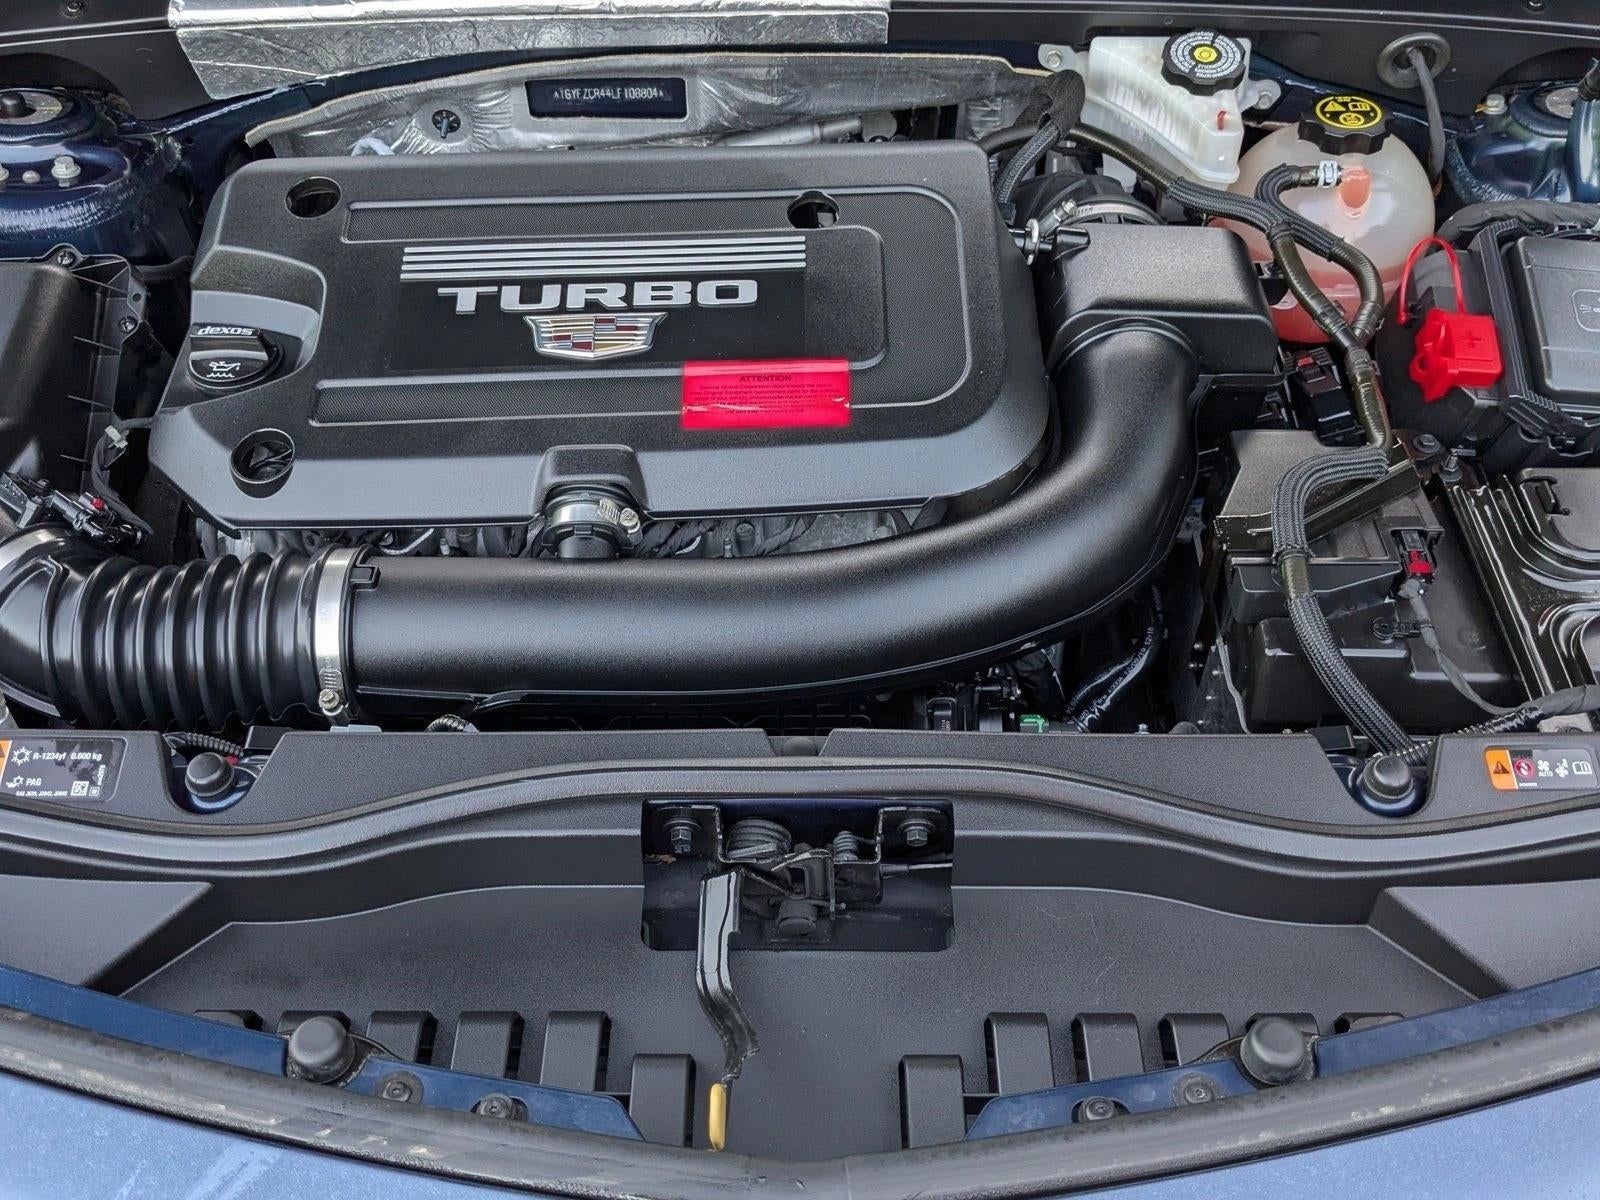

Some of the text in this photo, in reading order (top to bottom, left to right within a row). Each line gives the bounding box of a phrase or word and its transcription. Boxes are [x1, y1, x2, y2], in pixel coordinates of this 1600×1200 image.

[437, 279, 758, 314] TURBO
[197, 325, 254, 336] dexos
[32, 752, 103, 761] R-1234yf 0.600 kg
[25, 777, 42, 787] PAG
